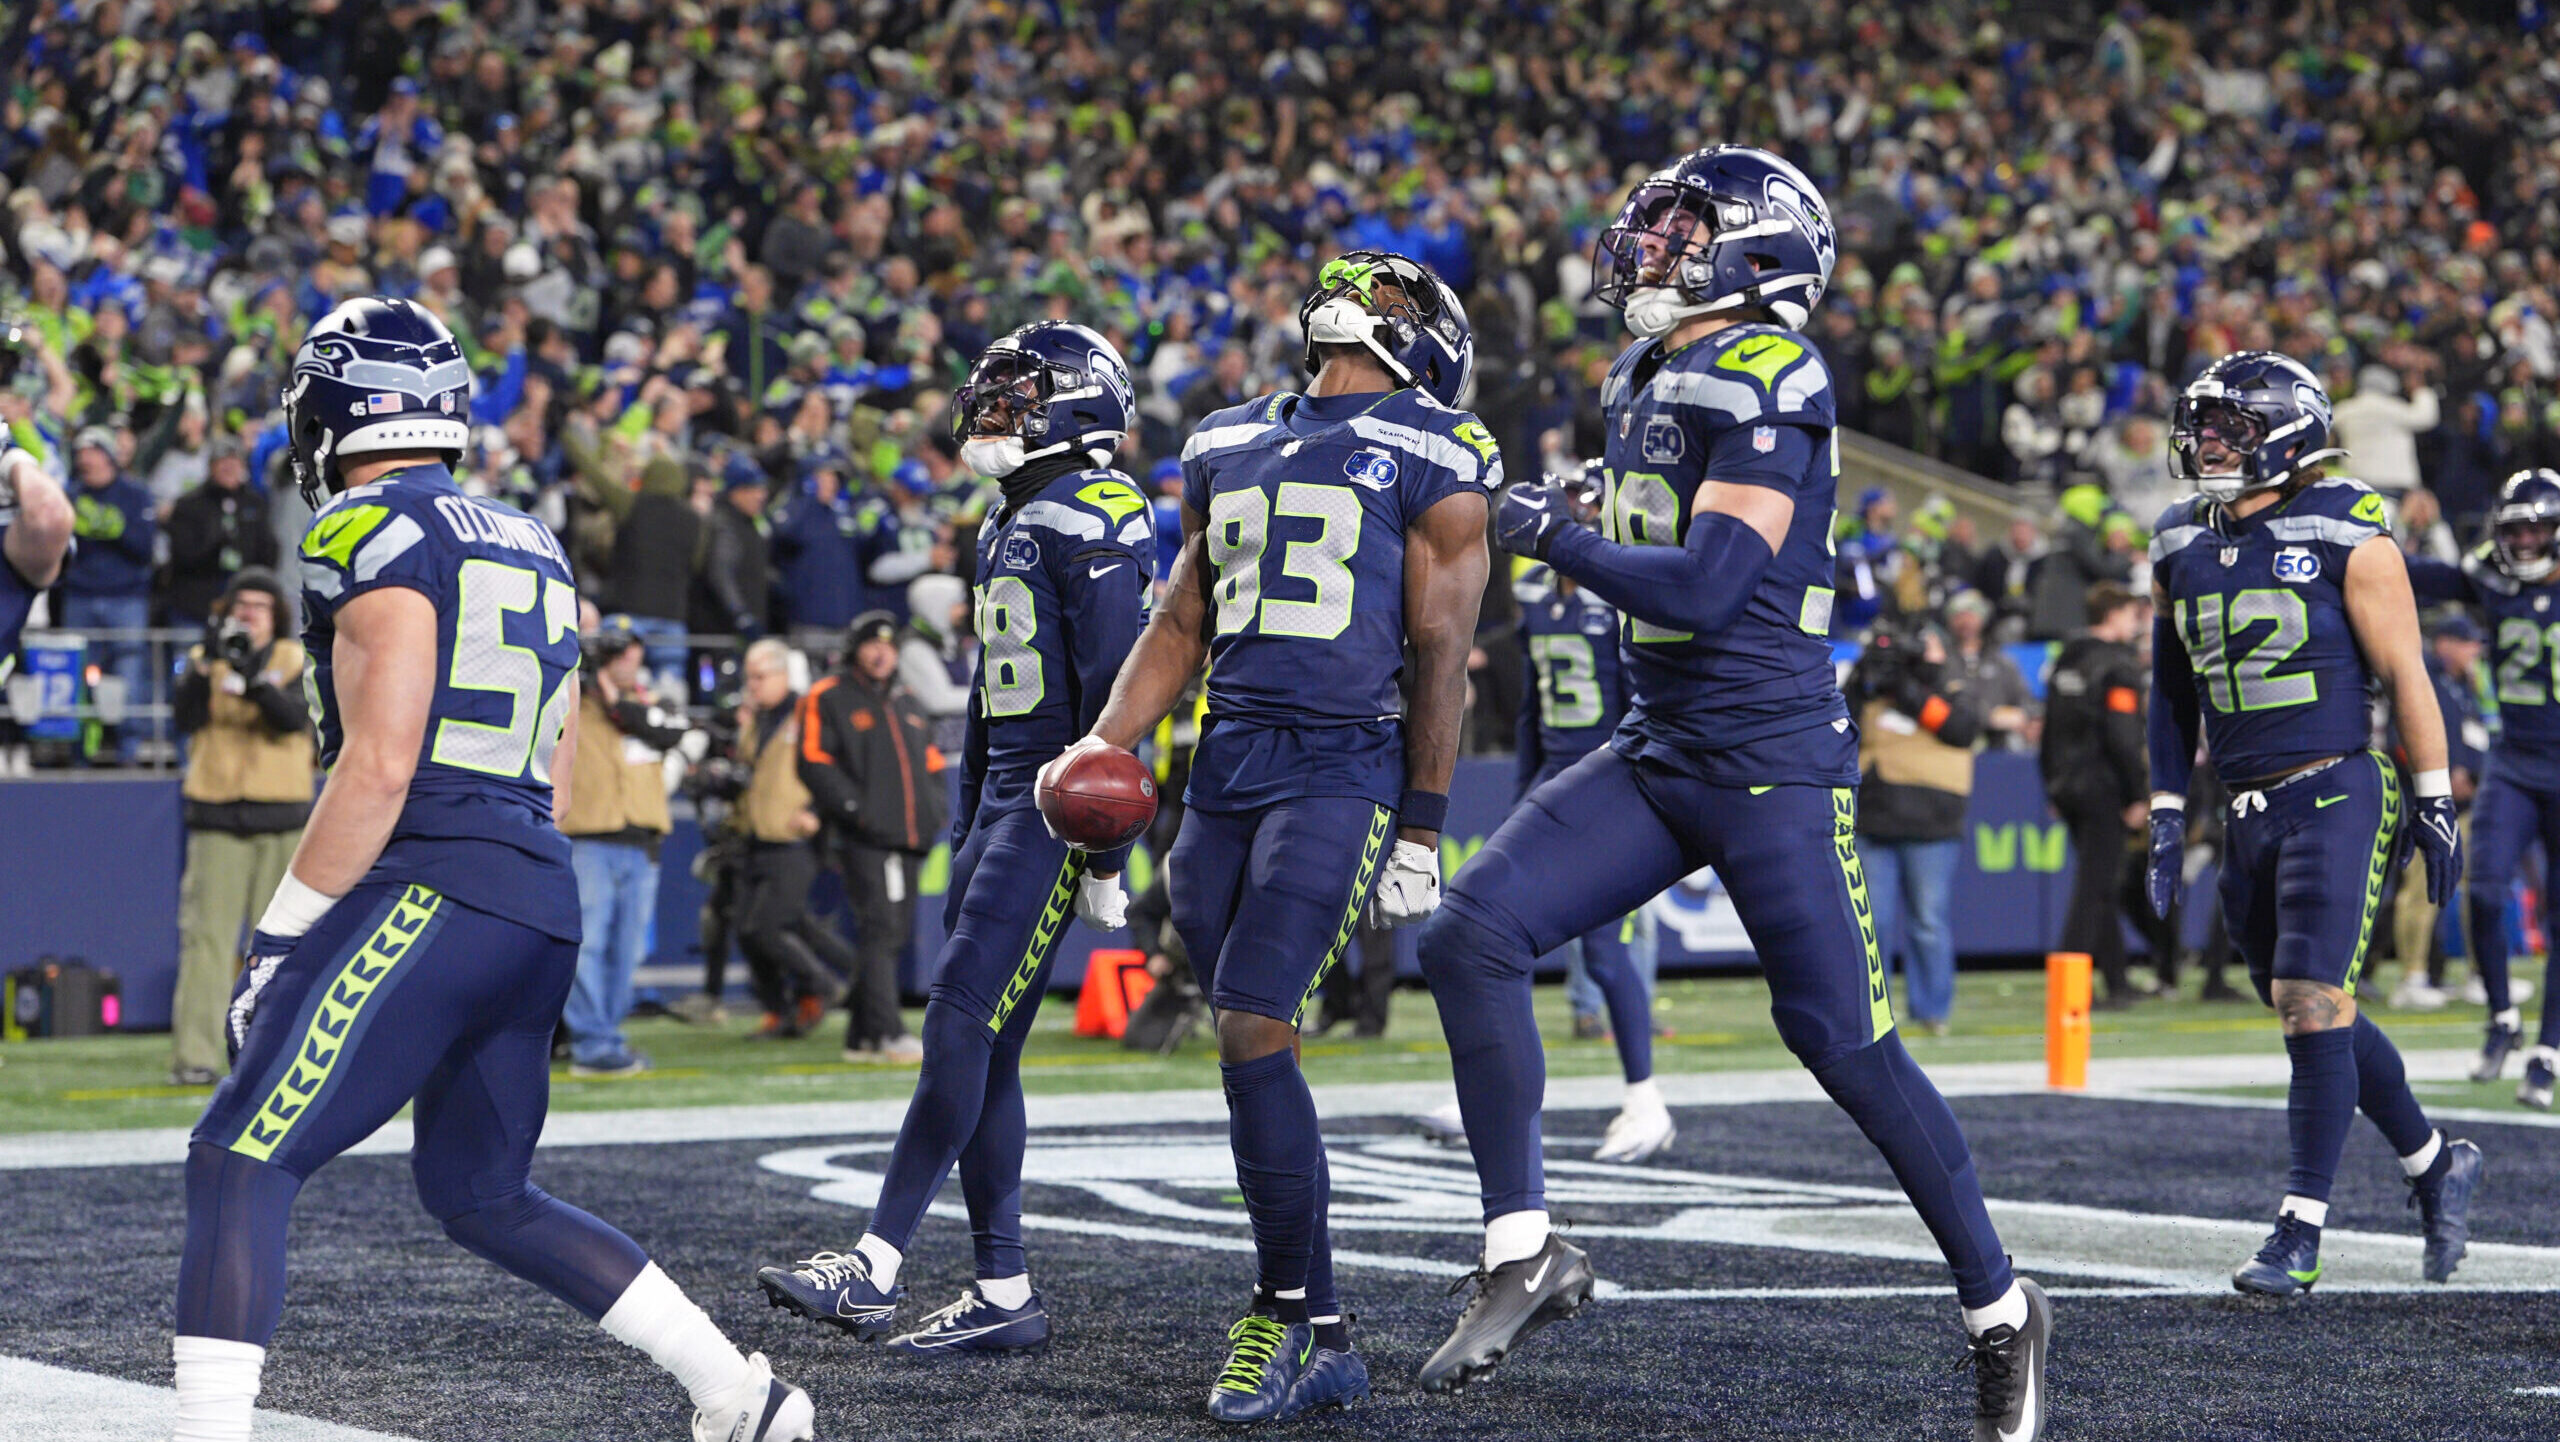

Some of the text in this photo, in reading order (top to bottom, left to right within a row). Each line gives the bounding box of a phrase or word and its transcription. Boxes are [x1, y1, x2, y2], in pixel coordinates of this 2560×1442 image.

[349, 401, 367, 417] 45
[1206, 482, 1364, 640] 83
[2275, 554, 2318, 577] 50
[1529, 633, 1604, 728] 13
[2174, 588, 2318, 713] 42
